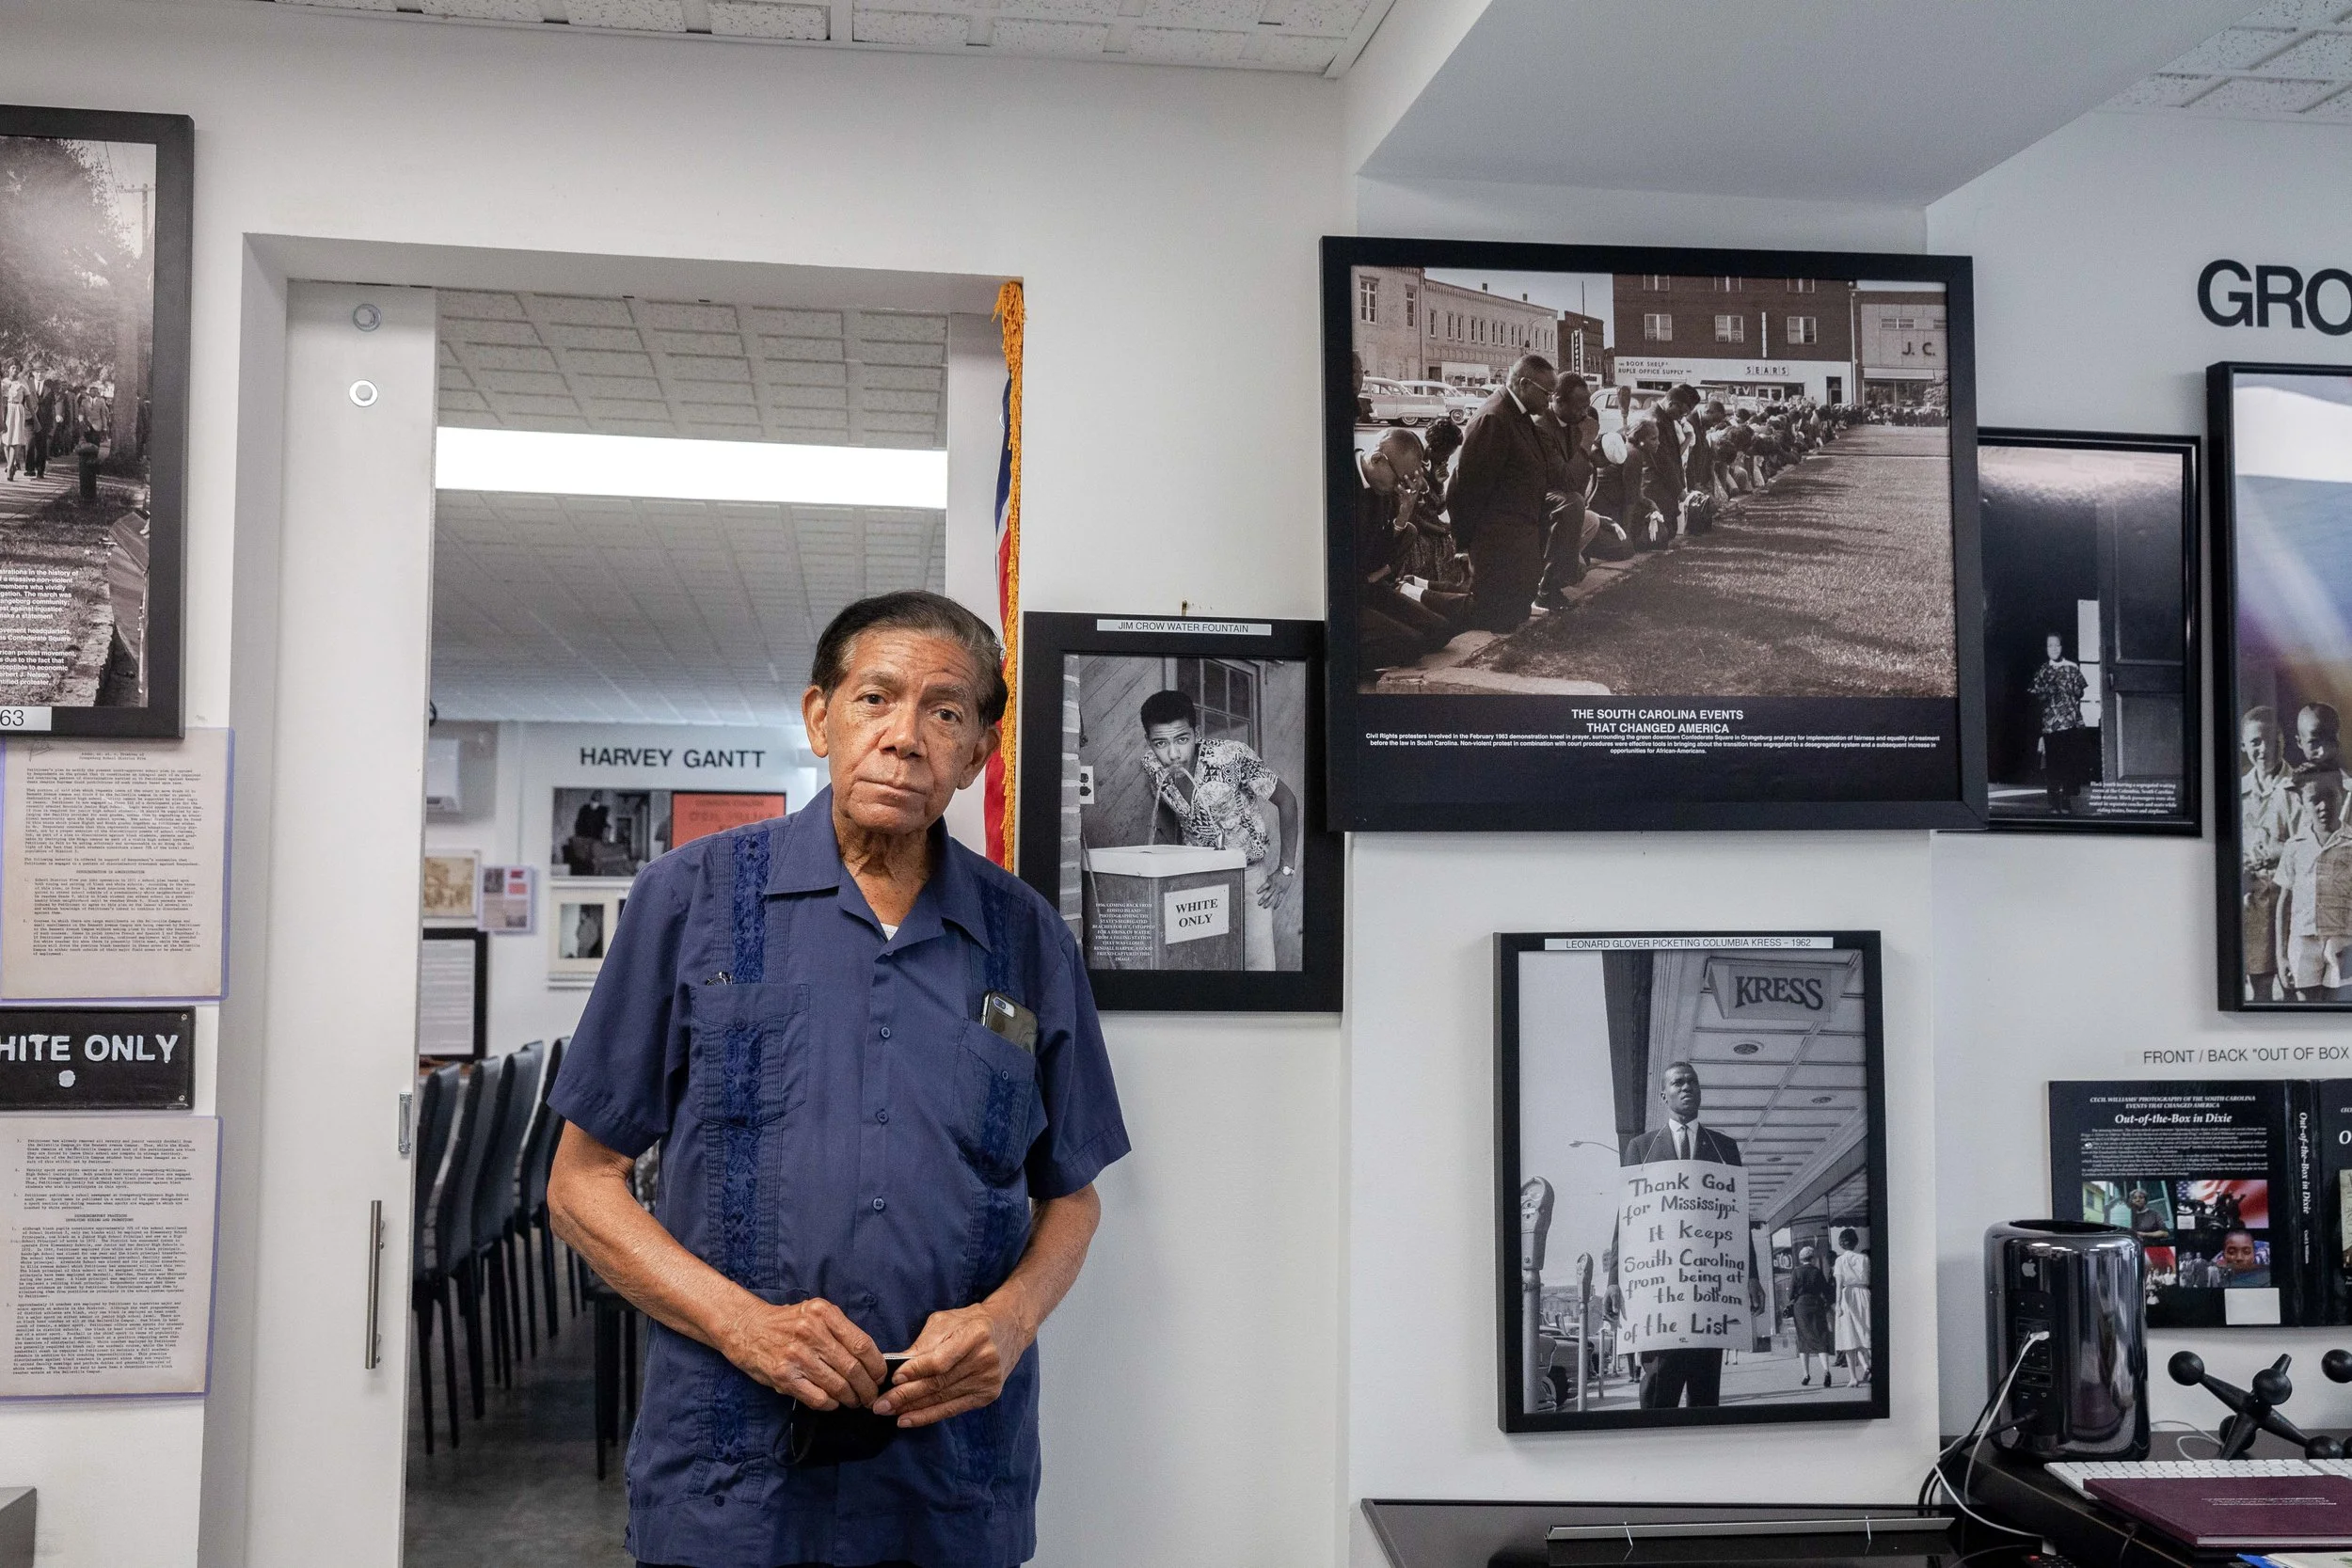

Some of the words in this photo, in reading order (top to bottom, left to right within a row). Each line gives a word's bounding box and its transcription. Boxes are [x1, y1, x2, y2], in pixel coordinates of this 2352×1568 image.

[2198, 259, 2352, 336] GRO
[1746, 366, 1788, 375] SEARS
[1135, 622, 1165, 630] CROW
[1167, 623, 1200, 631] WATER
[1202, 624, 1249, 633] FOUNTAIN
[1571, 709, 1594, 719] THE
[1597, 709, 1636, 720] SOUTH
[1638, 709, 1697, 720] CAROLINA
[1700, 710, 1744, 720] EVENTS
[1586, 723, 1616, 733] THAT
[1619, 723, 1675, 733] CHANGED
[1678, 723, 1730, 733] AMERICA
[580, 748, 673, 768] HARVEY
[683, 749, 766, 768] GANTT
[1176, 899, 1217, 913] WHITE
[1179, 913, 1213, 927] ONLY
[1566, 940, 1610, 949] LEONARD
[1612, 940, 1650, 948] GLOVER
[1652, 939, 1700, 948] PICKETING
[1702, 939, 1749, 947] COLUMBIA
[1751, 938, 1782, 947] KRESS
[1791, 938, 1811, 947] 1962
[1735, 976, 1823, 1010] KRESS
[85, 1035, 179, 1063] ONLY
[2143, 1050, 2195, 1064] FRONT
[2208, 1048, 2248, 1063] BACK
[2294, 1047, 2314, 1061] OF
[2319, 1046, 2350, 1060] BOX
[2115, 1113, 2191, 1126] Out-of-the-Box
[2193, 1113, 2203, 1123] in
[2205, 1113, 2233, 1123] Dixie
[2298, 1112, 2310, 1179] Out-of-the-Box
[1628, 1172, 1690, 1196] Thank
[1702, 1174, 1736, 1193] God
[1622, 1204, 1651, 1226] for
[1661, 1195, 1740, 1219] Mississippi
[1648, 1225, 1664, 1243] It
[1624, 1249, 1673, 1274] South
[1679, 1249, 1744, 1271] Carolina
[1626, 1275, 1665, 1300] from
[1678, 1268, 1722, 1291] being
[1726, 1270, 1744, 1283] at
[1654, 1285, 1685, 1304] the
[1693, 1284, 1742, 1306] bottom
[1624, 1323, 1638, 1344] of
[1644, 1312, 1677, 1336] the
[1691, 1313, 1741, 1336] List
